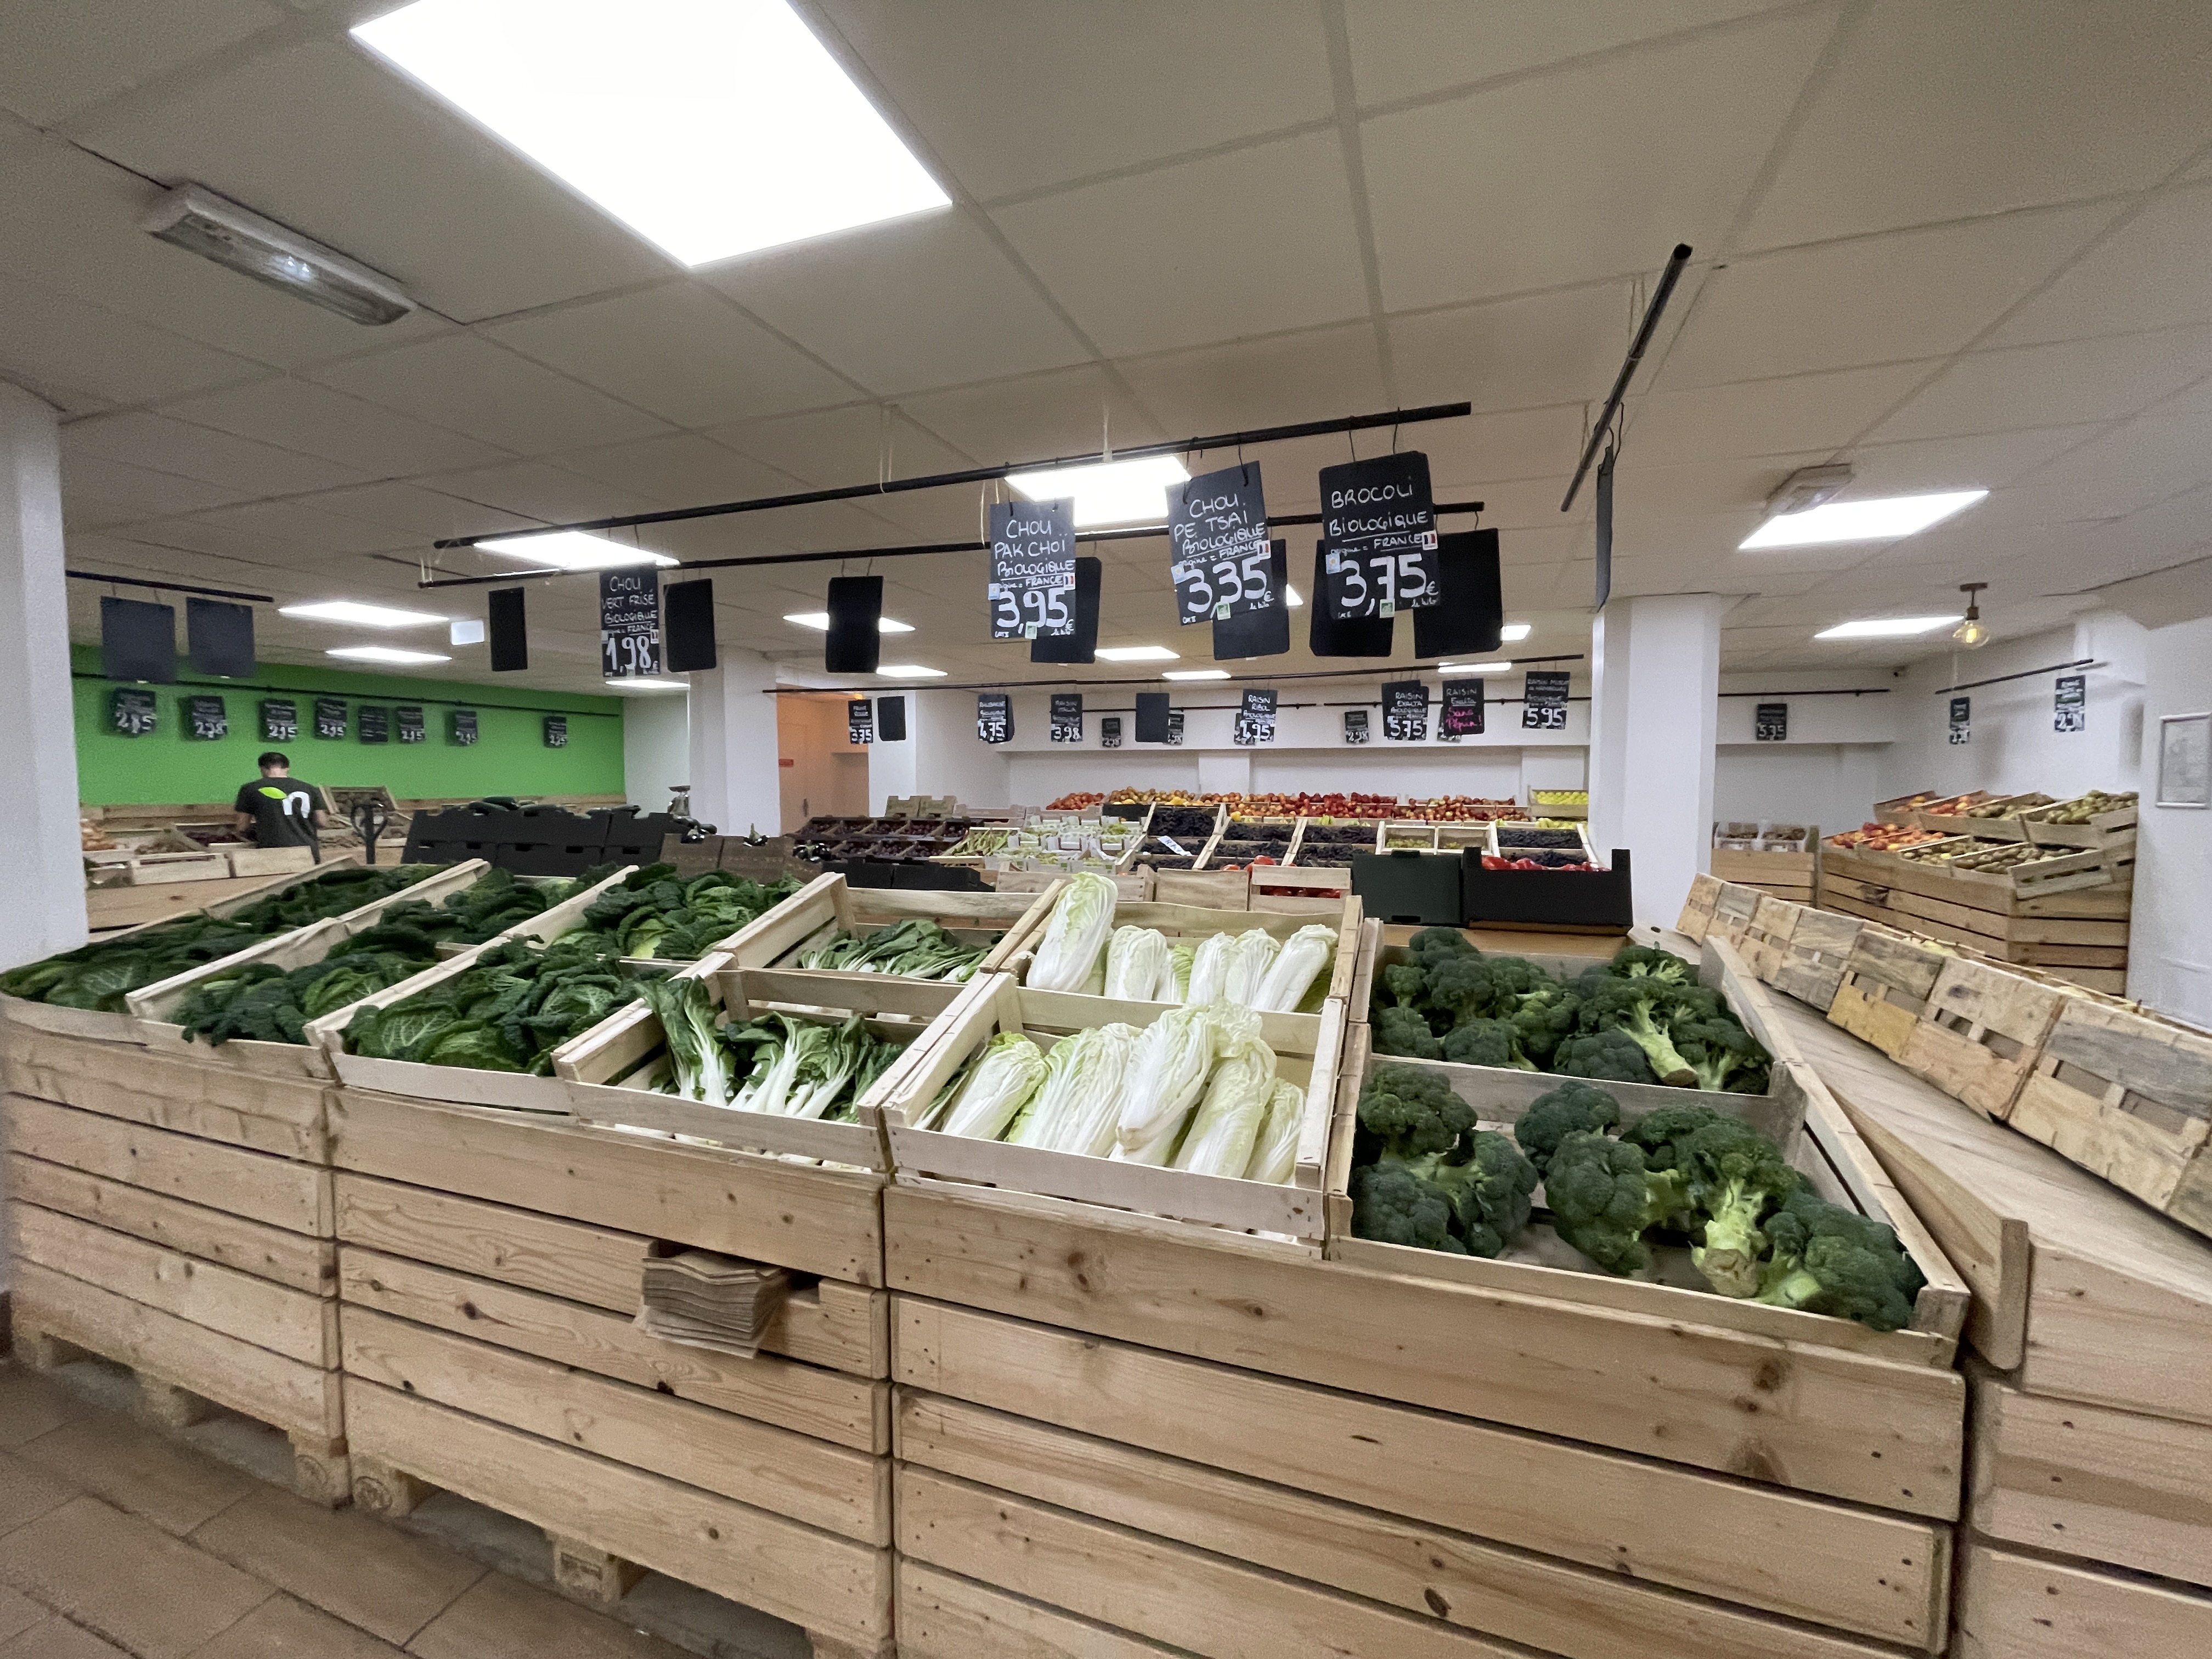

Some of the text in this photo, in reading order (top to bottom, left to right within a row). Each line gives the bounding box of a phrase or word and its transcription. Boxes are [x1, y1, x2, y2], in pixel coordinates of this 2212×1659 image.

[1331, 476, 1413, 509] BROCOLI
[1189, 494, 1238, 518] CHOU
[1006, 520, 1052, 539] CHOU
[1374, 533, 1422, 549] FRANCE
[994, 541, 1024, 560] PAK
[610, 576, 641, 592] CHOU
[1026, 575, 1063, 586] FRANCE
[1446, 688, 1477, 696] RAISIN
